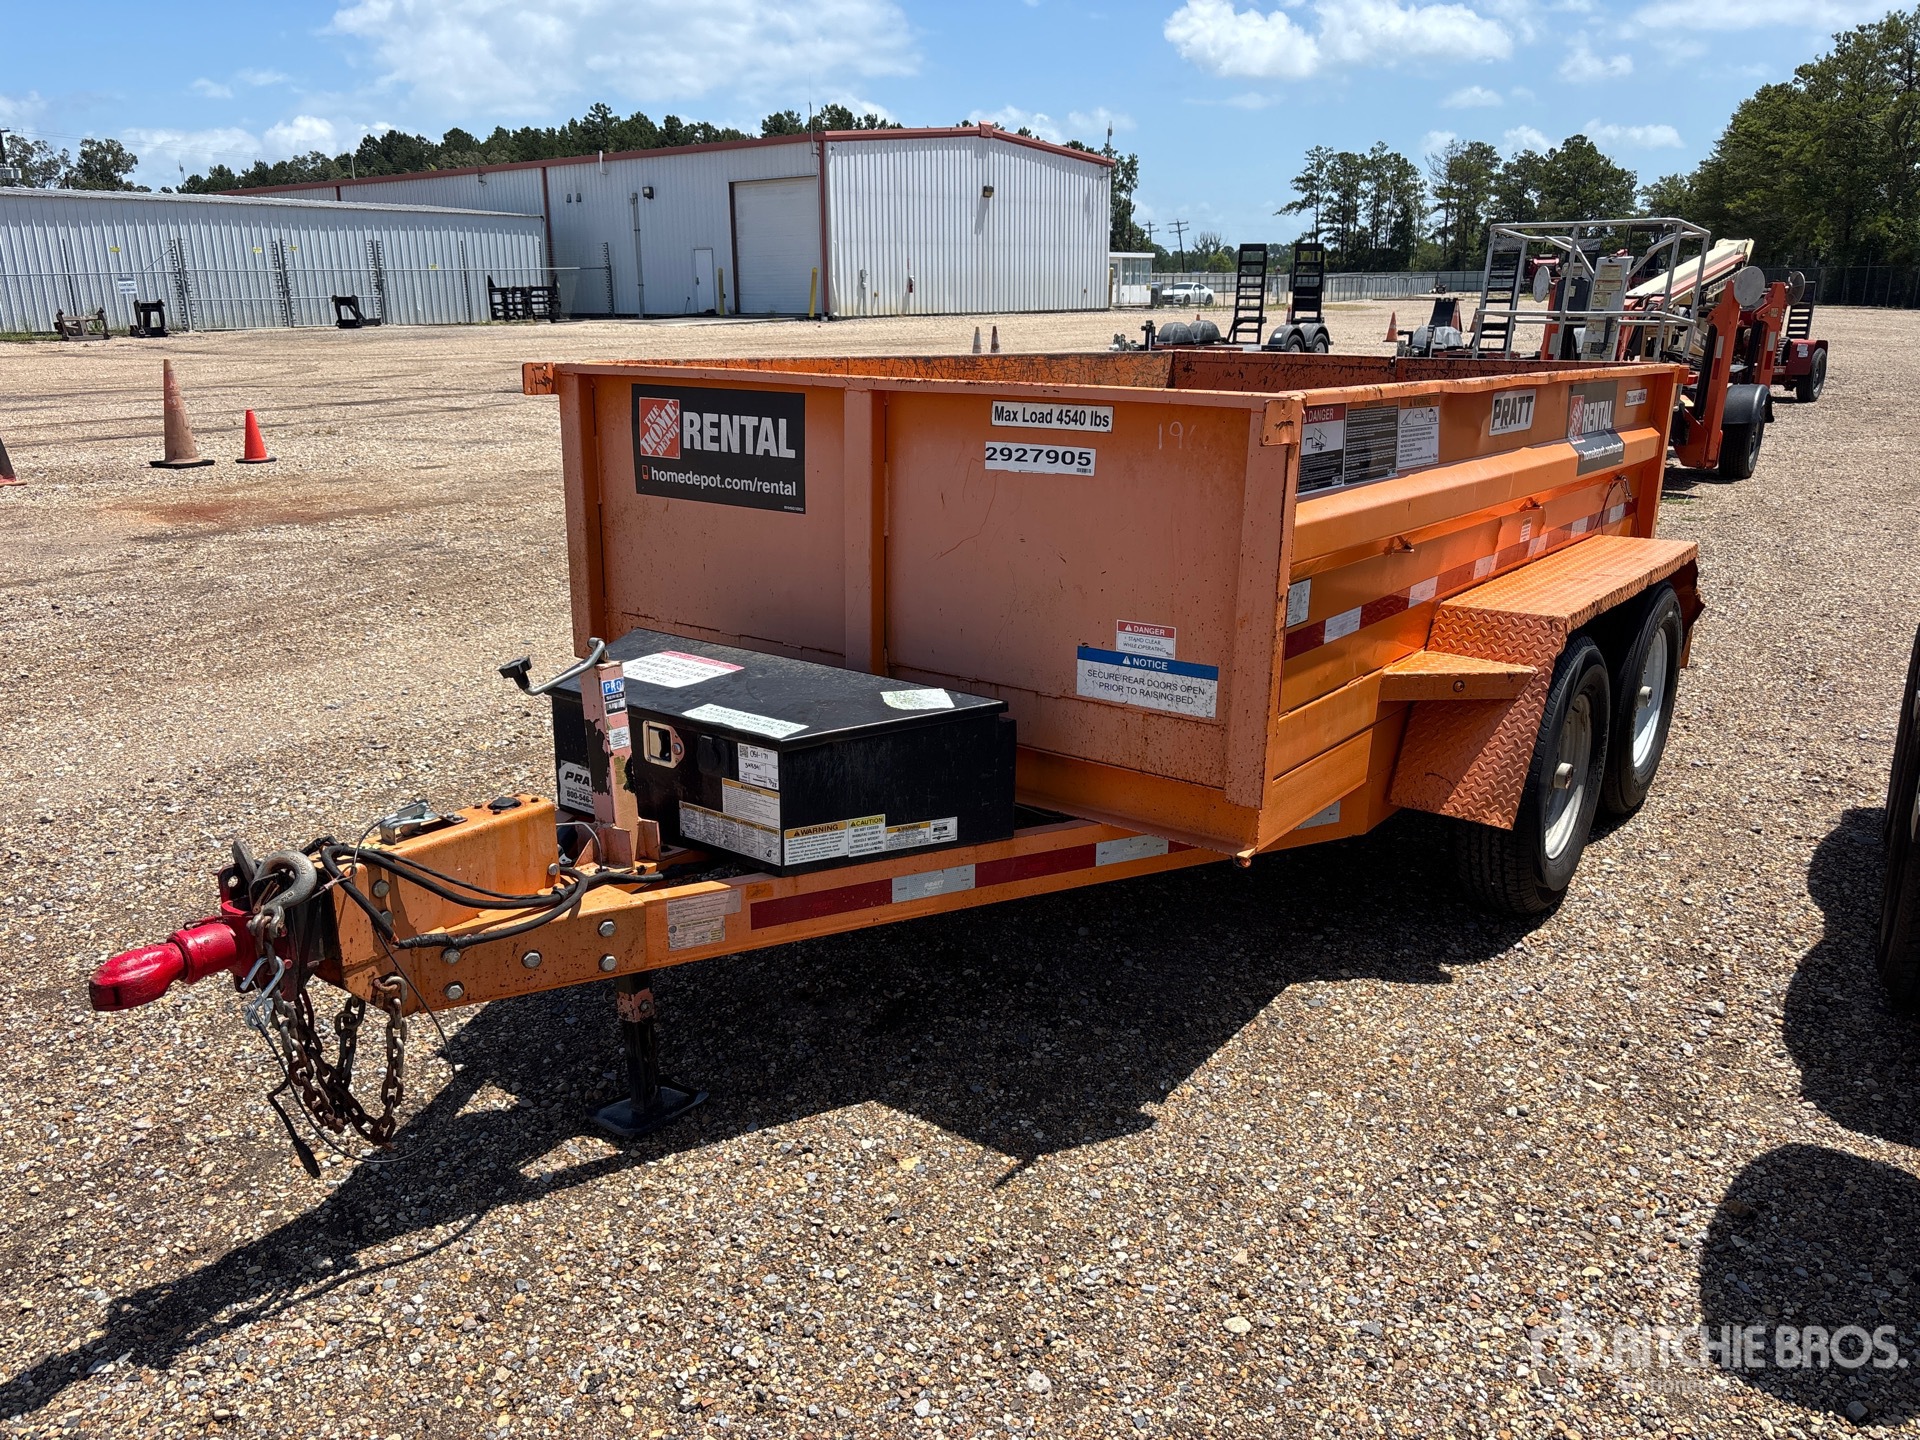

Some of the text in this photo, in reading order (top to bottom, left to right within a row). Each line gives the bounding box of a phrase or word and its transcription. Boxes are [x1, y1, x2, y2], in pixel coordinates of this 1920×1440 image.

[643, 404, 661, 427] THE
[994, 405, 1110, 428] Max Load 4540 lbs
[1308, 408, 1334, 420] DANGER
[1491, 395, 1534, 429] PRATT
[1582, 401, 1612, 434] RENTAL
[640, 399, 680, 456] HOME
[656, 422, 680, 456] DEPOT
[683, 411, 796, 459] RENTAL
[985, 447, 1092, 466] 2927905
[651, 467, 797, 496] homedepot.com/rental
[1133, 625, 1165, 636] DANGER
[1132, 657, 1168, 670] NOTICE
[604, 680, 622, 692] PRO
[1087, 669, 1205, 695] SECURE REAR DOORS OPEN
[1098, 682, 1194, 705] PRIOR TO RAISING BED
[564, 770, 590, 787] PRA
[800, 824, 838, 836] WARNING
[855, 817, 883, 826] CAUTION
